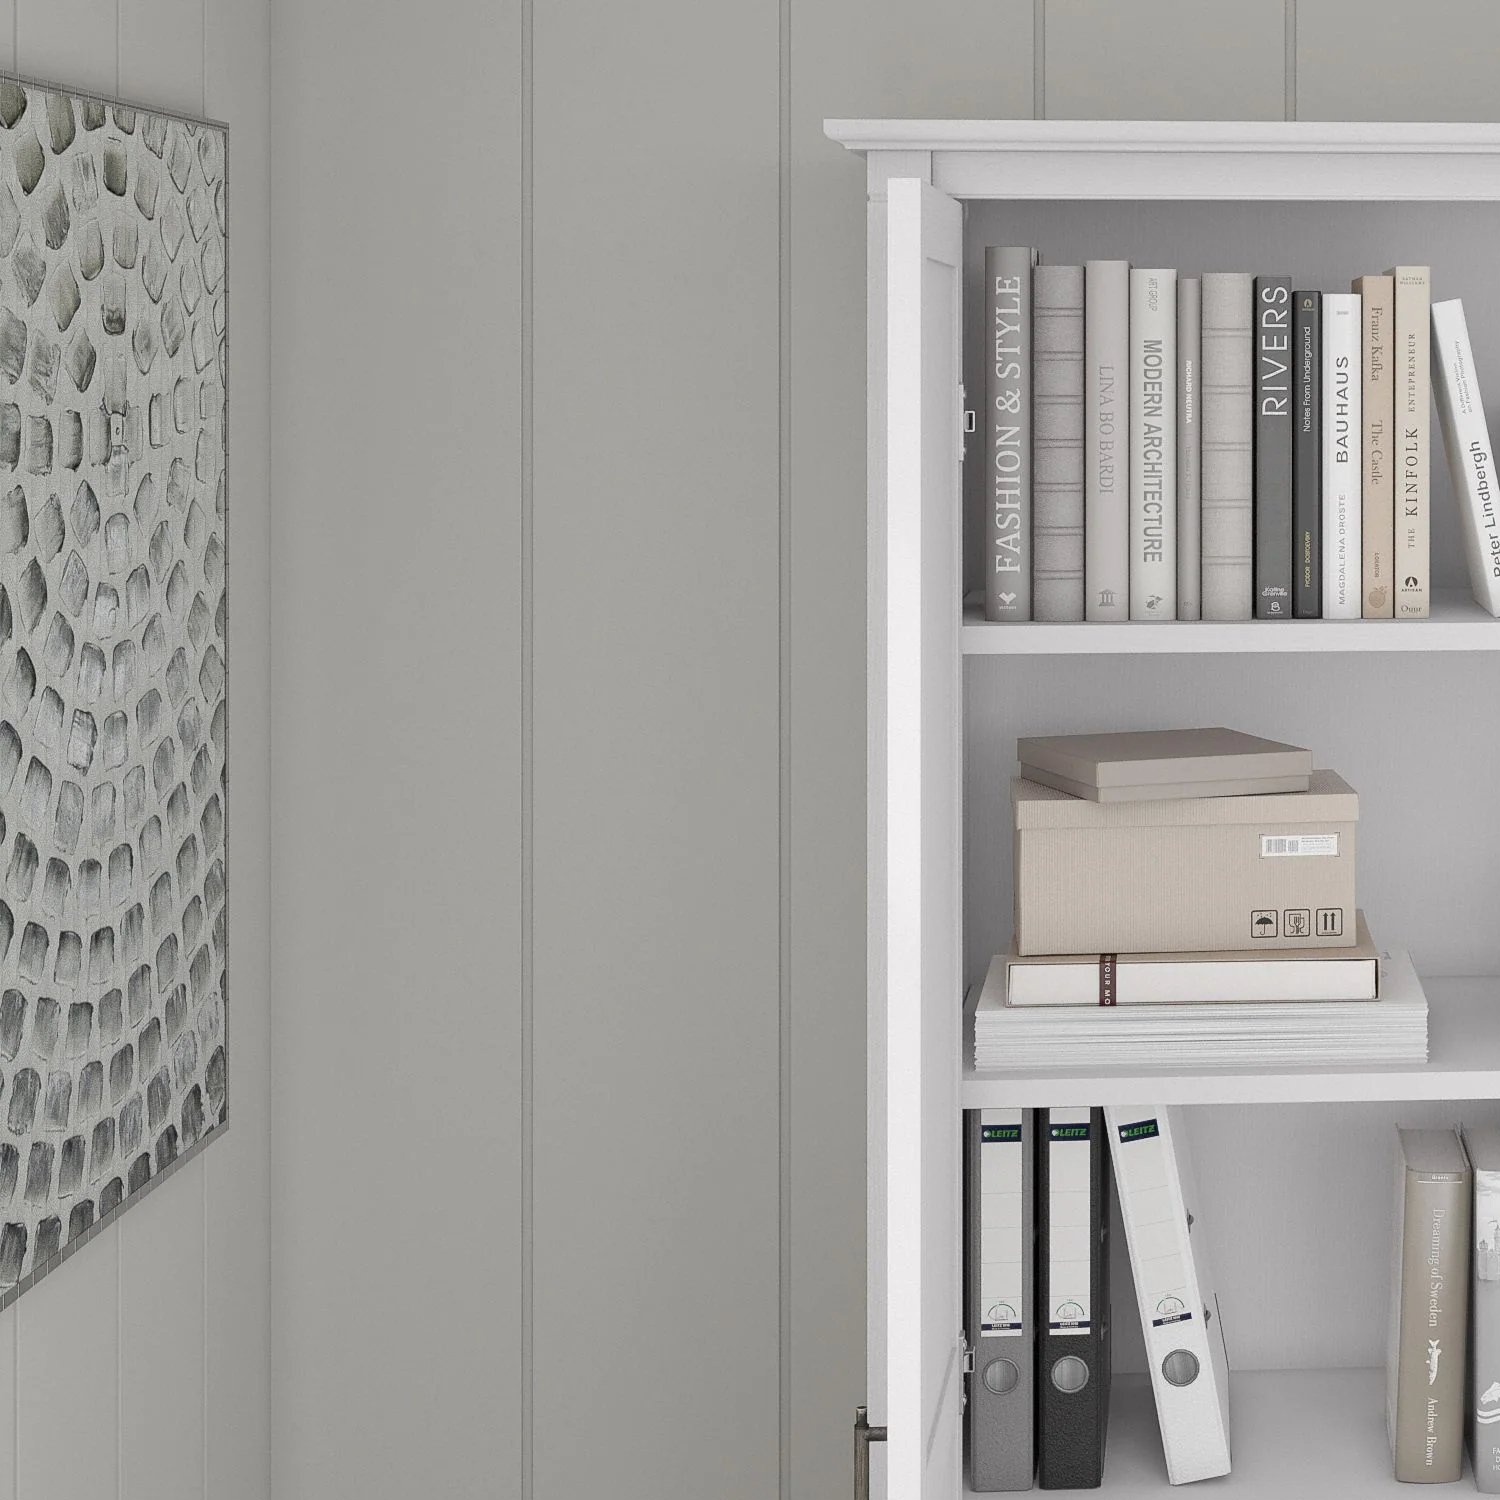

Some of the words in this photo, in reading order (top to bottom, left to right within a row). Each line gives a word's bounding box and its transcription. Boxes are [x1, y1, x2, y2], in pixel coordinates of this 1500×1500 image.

[996, 276, 1021, 380] STYLE
[1371, 307, 1383, 342] Franz
[1262, 286, 1288, 416] RIVERS
[1302, 327, 1311, 383] Underground
[1371, 345, 1383, 381] Kafka
[1099, 365, 1115, 406] LINA
[1144, 340, 1162, 416] MODERN
[996, 388, 1021, 414] &
[1336, 356, 1349, 463] BAUHAUS
[1099, 412, 1115, 435] BO
[1371, 420, 1383, 445] The
[1099, 441, 1115, 495] BARDI
[1371, 449, 1383, 486] Castle
[1406, 428, 1418, 517] KINFOLK
[1470, 440, 1495, 528] Lindbergh
[996, 423, 1021, 574] FASHION
[1144, 422, 1162, 563] ARCHITECTURE
[991, 1130, 1018, 1138] LEITZ
[1059, 1128, 1087, 1137] LEITZ
[1128, 1125, 1155, 1136] LEITZ
[1427, 1208, 1445, 1265] Dreaming
[1430, 1268, 1443, 1279] of
[1429, 1282, 1442, 1328] Sweden
[1426, 1397, 1438, 1432] Andrew
[1425, 1436, 1436, 1466] Brown
